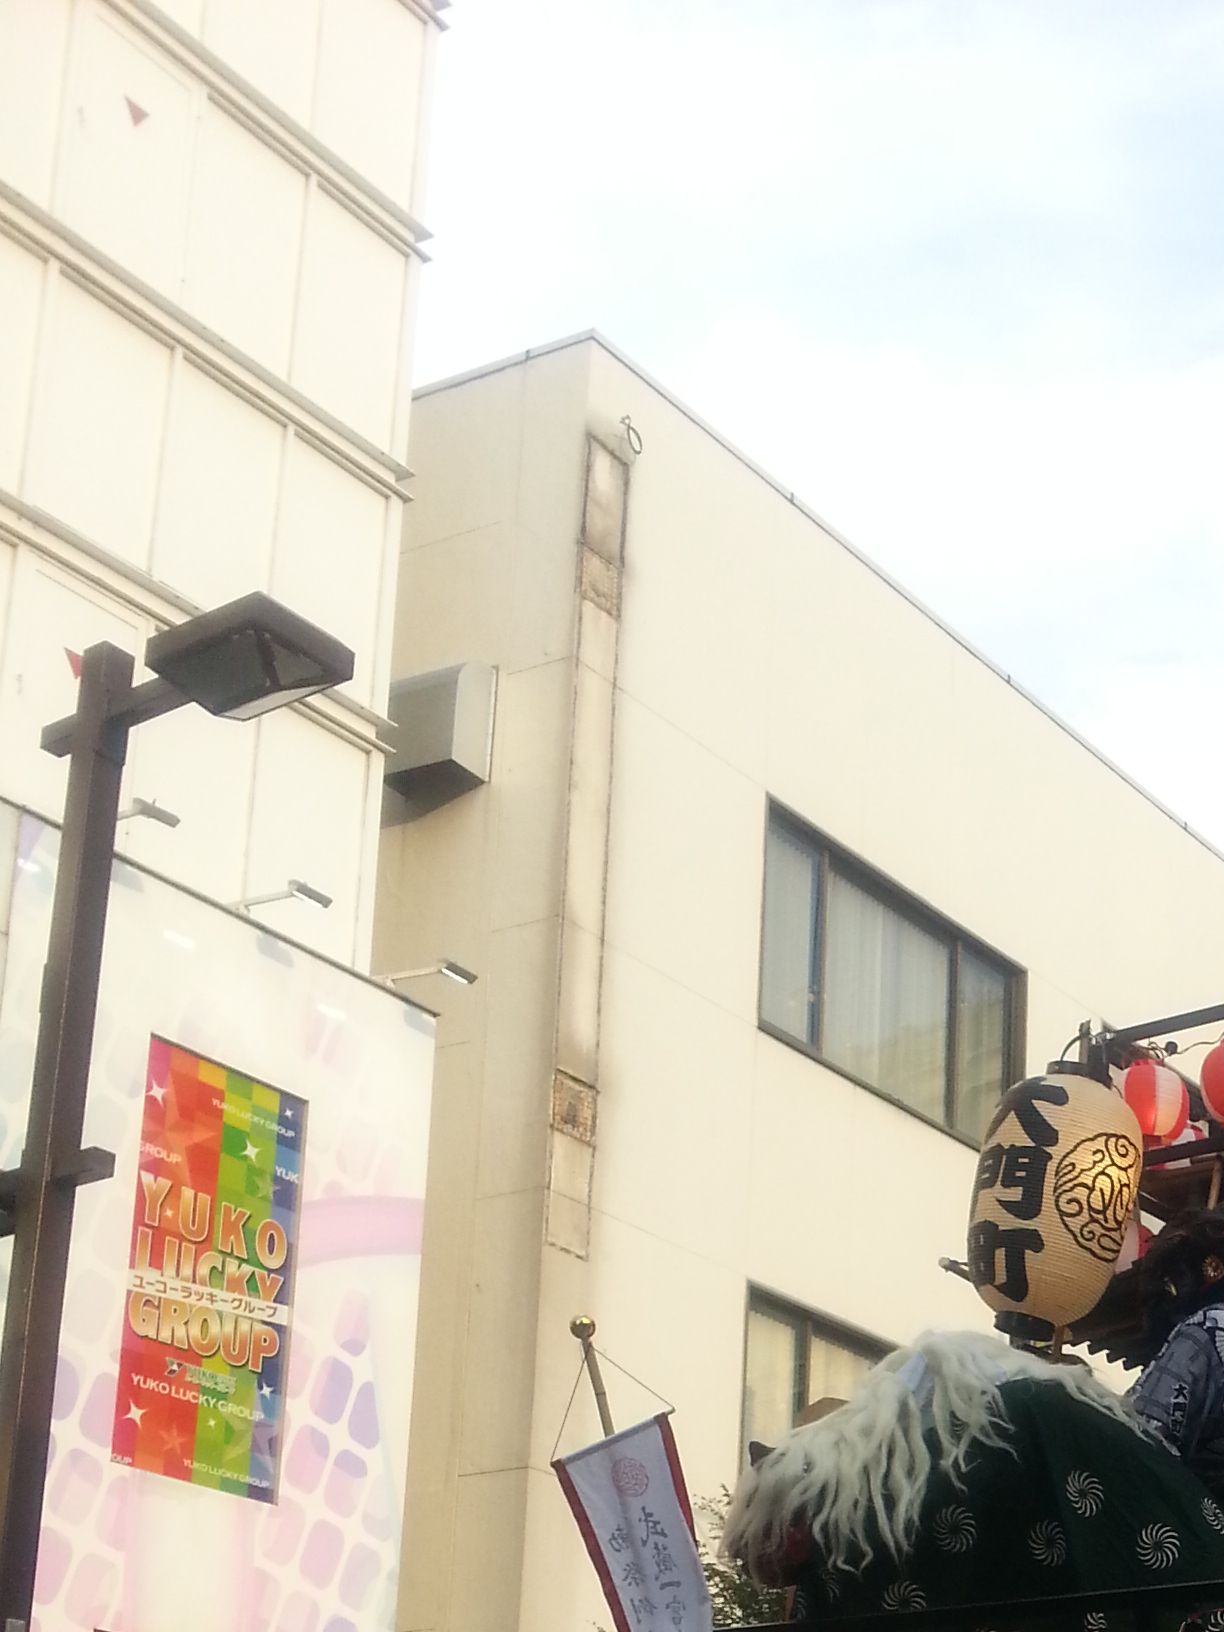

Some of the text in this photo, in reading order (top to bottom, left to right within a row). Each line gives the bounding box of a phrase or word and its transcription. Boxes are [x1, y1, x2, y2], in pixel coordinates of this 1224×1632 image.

[265, 1119, 295, 1138] GROUP
[140, 1170, 287, 1269] YUKO
[968, 1076, 1069, 1303] 大門町
[135, 1226, 284, 1303] LUCKY
[128, 1291, 279, 1373] GROUP
[132, 1373, 170, 1395] YUKO
[171, 1386, 217, 1409] LUCKY
[218, 1400, 264, 1421] GROUP
[183, 1458, 270, 1488] YUKO LUCKY GROUP
